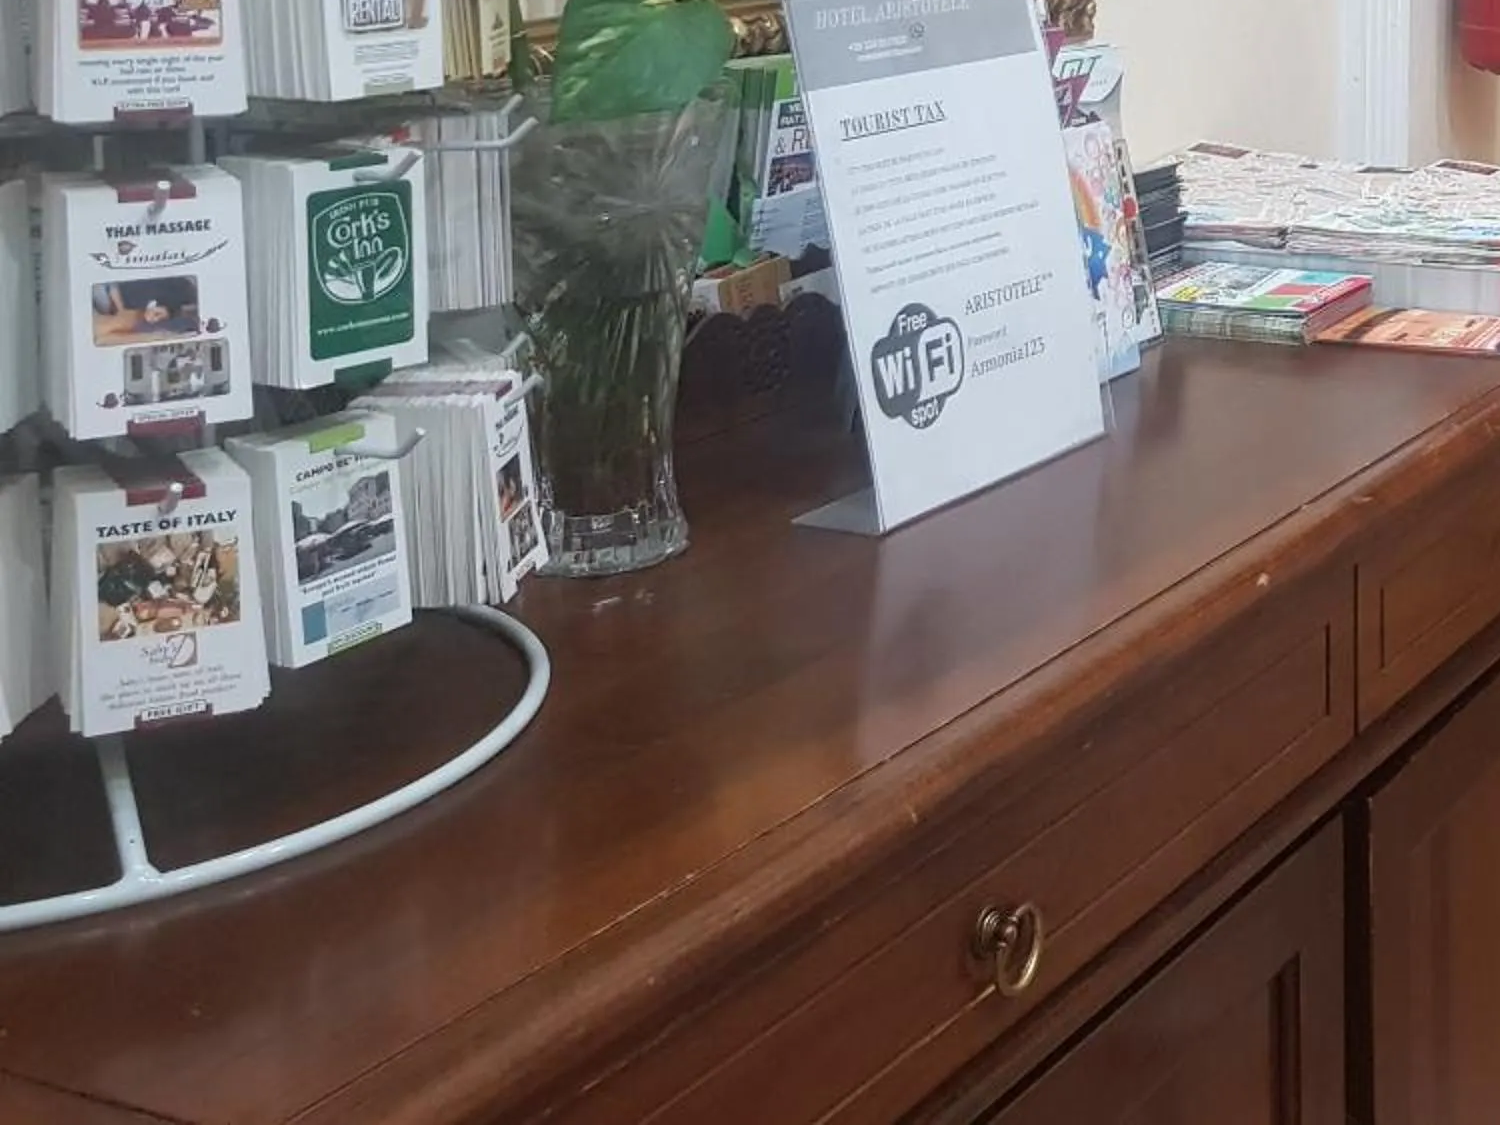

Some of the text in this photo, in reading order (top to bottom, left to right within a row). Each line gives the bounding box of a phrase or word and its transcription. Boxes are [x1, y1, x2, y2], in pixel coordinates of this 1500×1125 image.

[815, 5, 871, 30] HOTEL
[840, 100, 947, 138] TOURIST TAX
[105, 218, 211, 238] THAI MASSAGE
[327, 209, 390, 249] Cork's
[353, 235, 384, 259] Inn
[897, 312, 927, 335] Free
[910, 396, 940, 428] spot
[95, 509, 238, 539] TASTE OF ITALY
